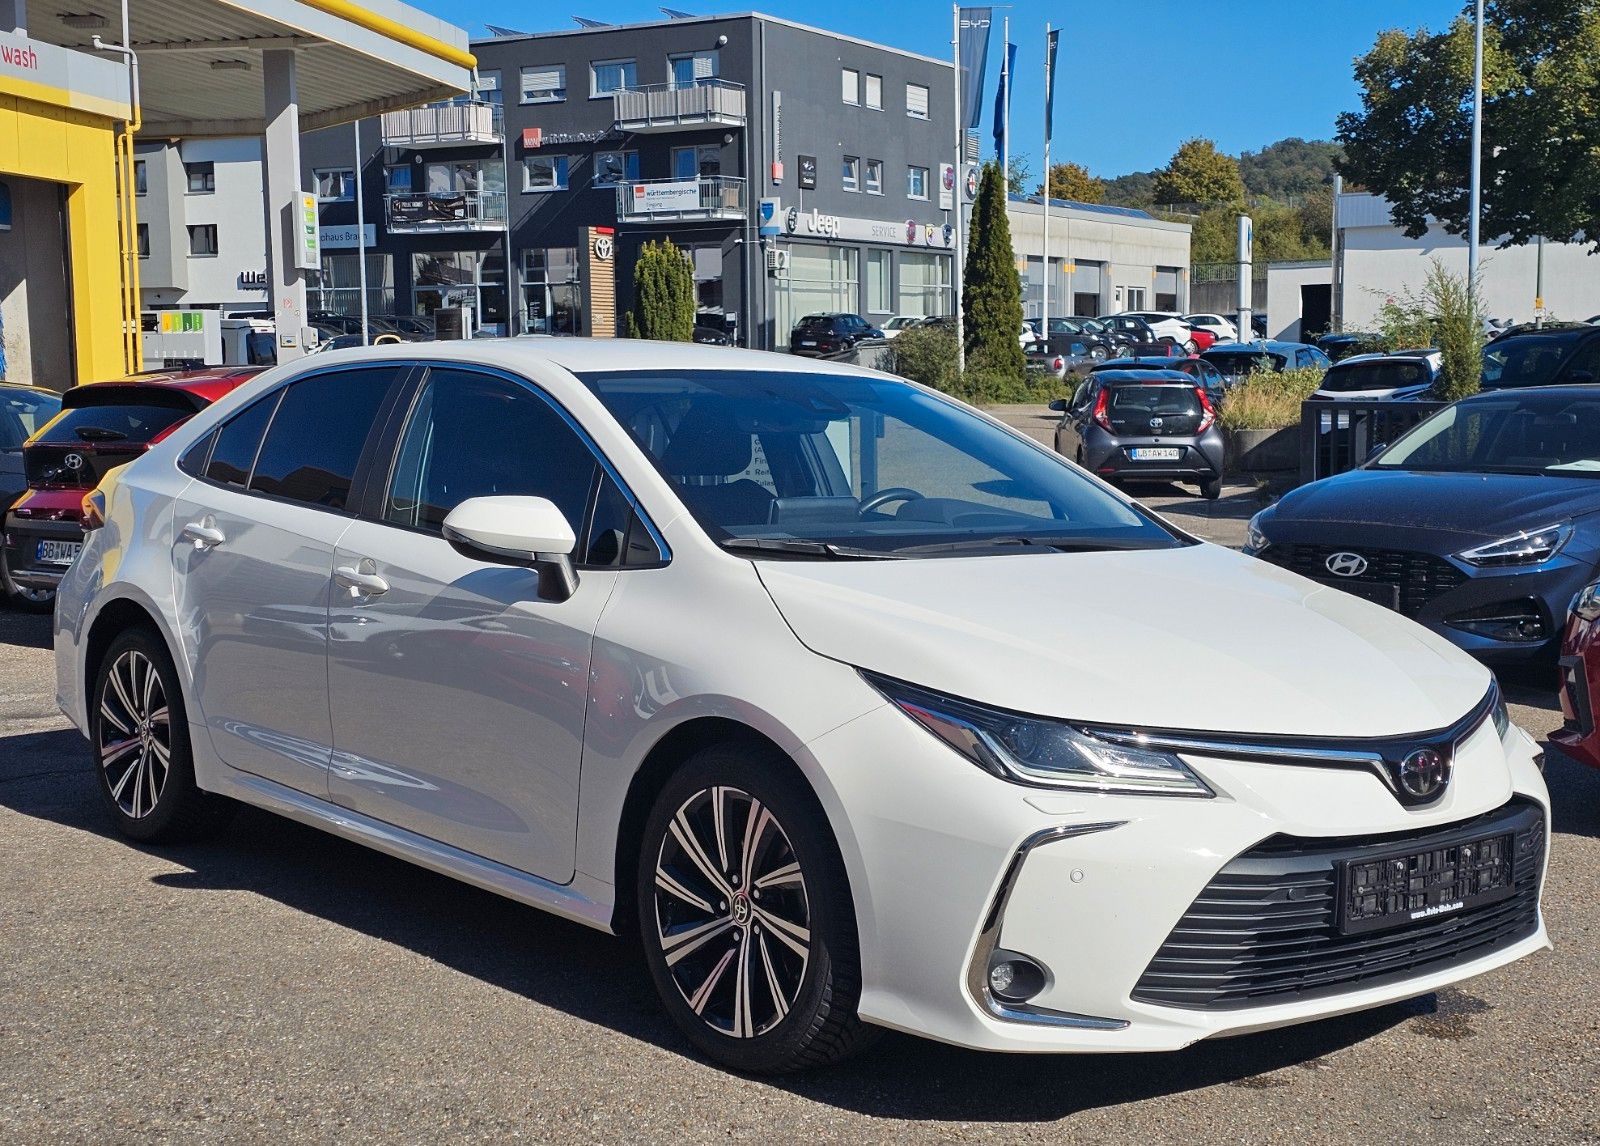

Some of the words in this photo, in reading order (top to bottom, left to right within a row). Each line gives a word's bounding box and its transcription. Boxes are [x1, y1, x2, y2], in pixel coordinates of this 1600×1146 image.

[960, 20, 990, 28] BYD
[1, 44, 37, 70] wash
[807, 208, 840, 237] Jeep
[320, 232, 344, 241] ohaus
[345, 232, 368, 241] Bran
[871, 225, 897, 238] SERVICE
[42, 542, 55, 559] BB
